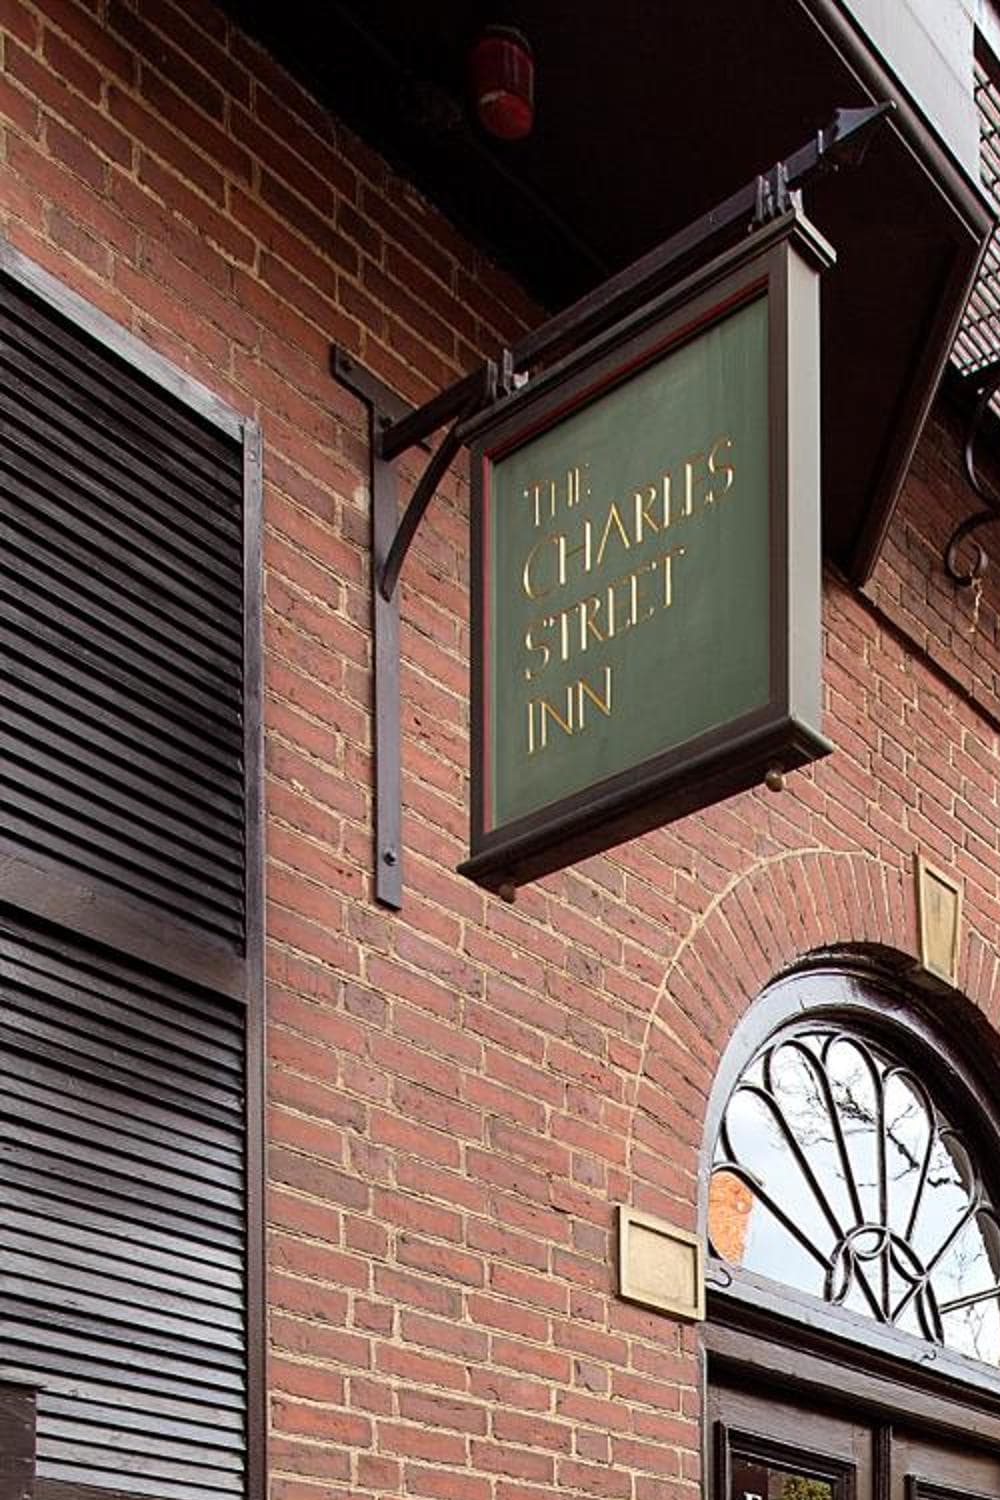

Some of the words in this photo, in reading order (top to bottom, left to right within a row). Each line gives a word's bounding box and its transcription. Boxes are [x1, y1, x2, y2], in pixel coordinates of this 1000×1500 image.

[522, 434, 735, 599] CHARLES
[523, 462, 592, 526] THE
[524, 547, 687, 680] STREET
[527, 665, 613, 755] INN
